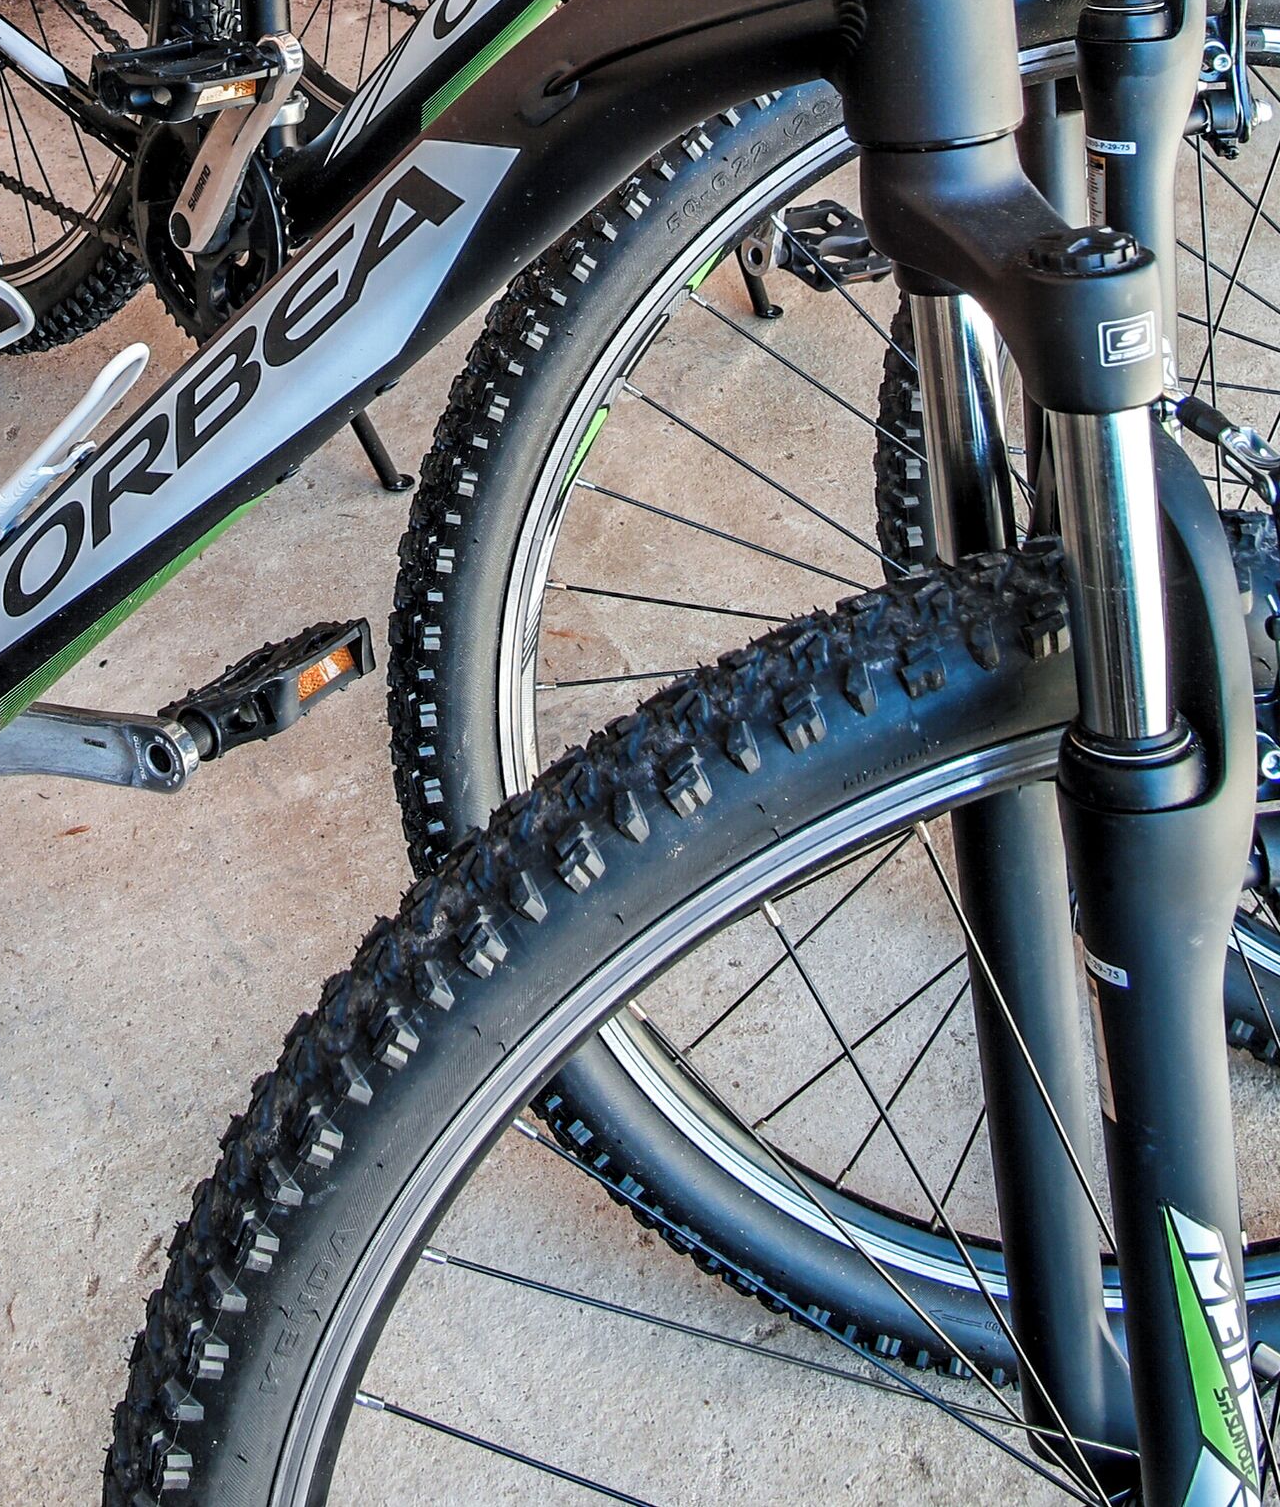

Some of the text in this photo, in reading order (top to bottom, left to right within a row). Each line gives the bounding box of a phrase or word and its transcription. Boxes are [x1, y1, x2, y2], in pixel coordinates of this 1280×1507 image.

[187, 164, 211, 212] SHIMANO
[3, 166, 465, 618] ORBEA
[1213, 1386, 1234, 1415] SR
